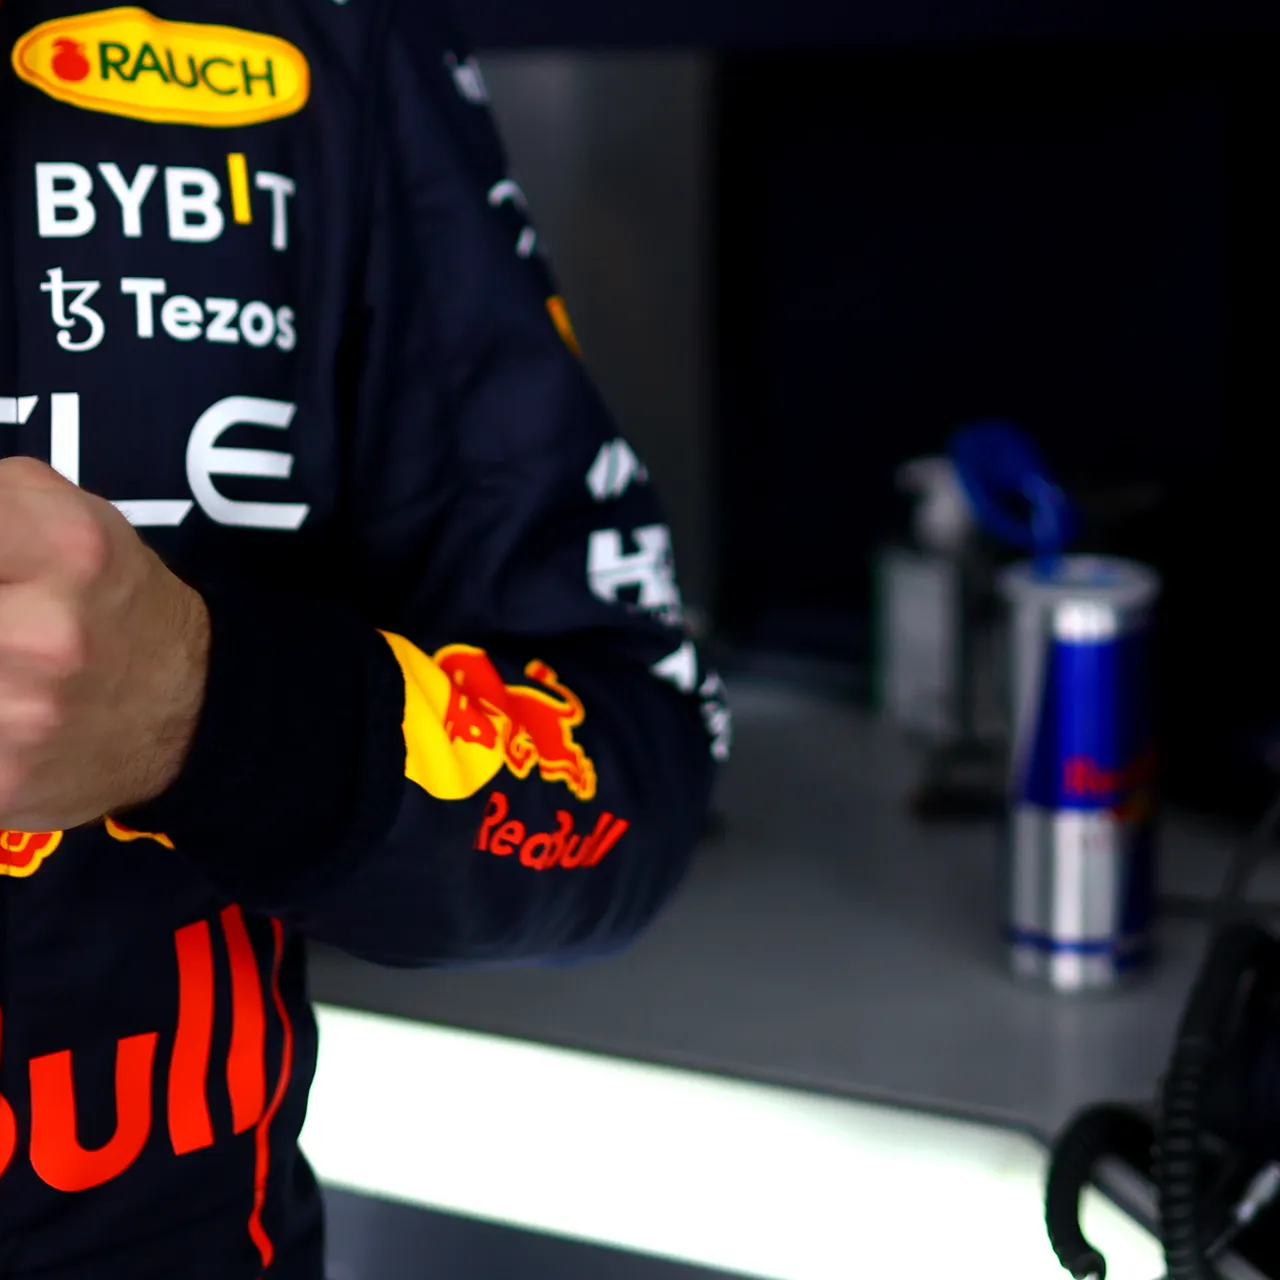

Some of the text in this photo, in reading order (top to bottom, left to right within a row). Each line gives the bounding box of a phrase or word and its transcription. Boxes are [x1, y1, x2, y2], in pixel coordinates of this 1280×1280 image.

[98, 40, 278, 100] RAUCH
[34, 153, 297, 251] BYBIT
[120, 276, 297, 353] Tezos
